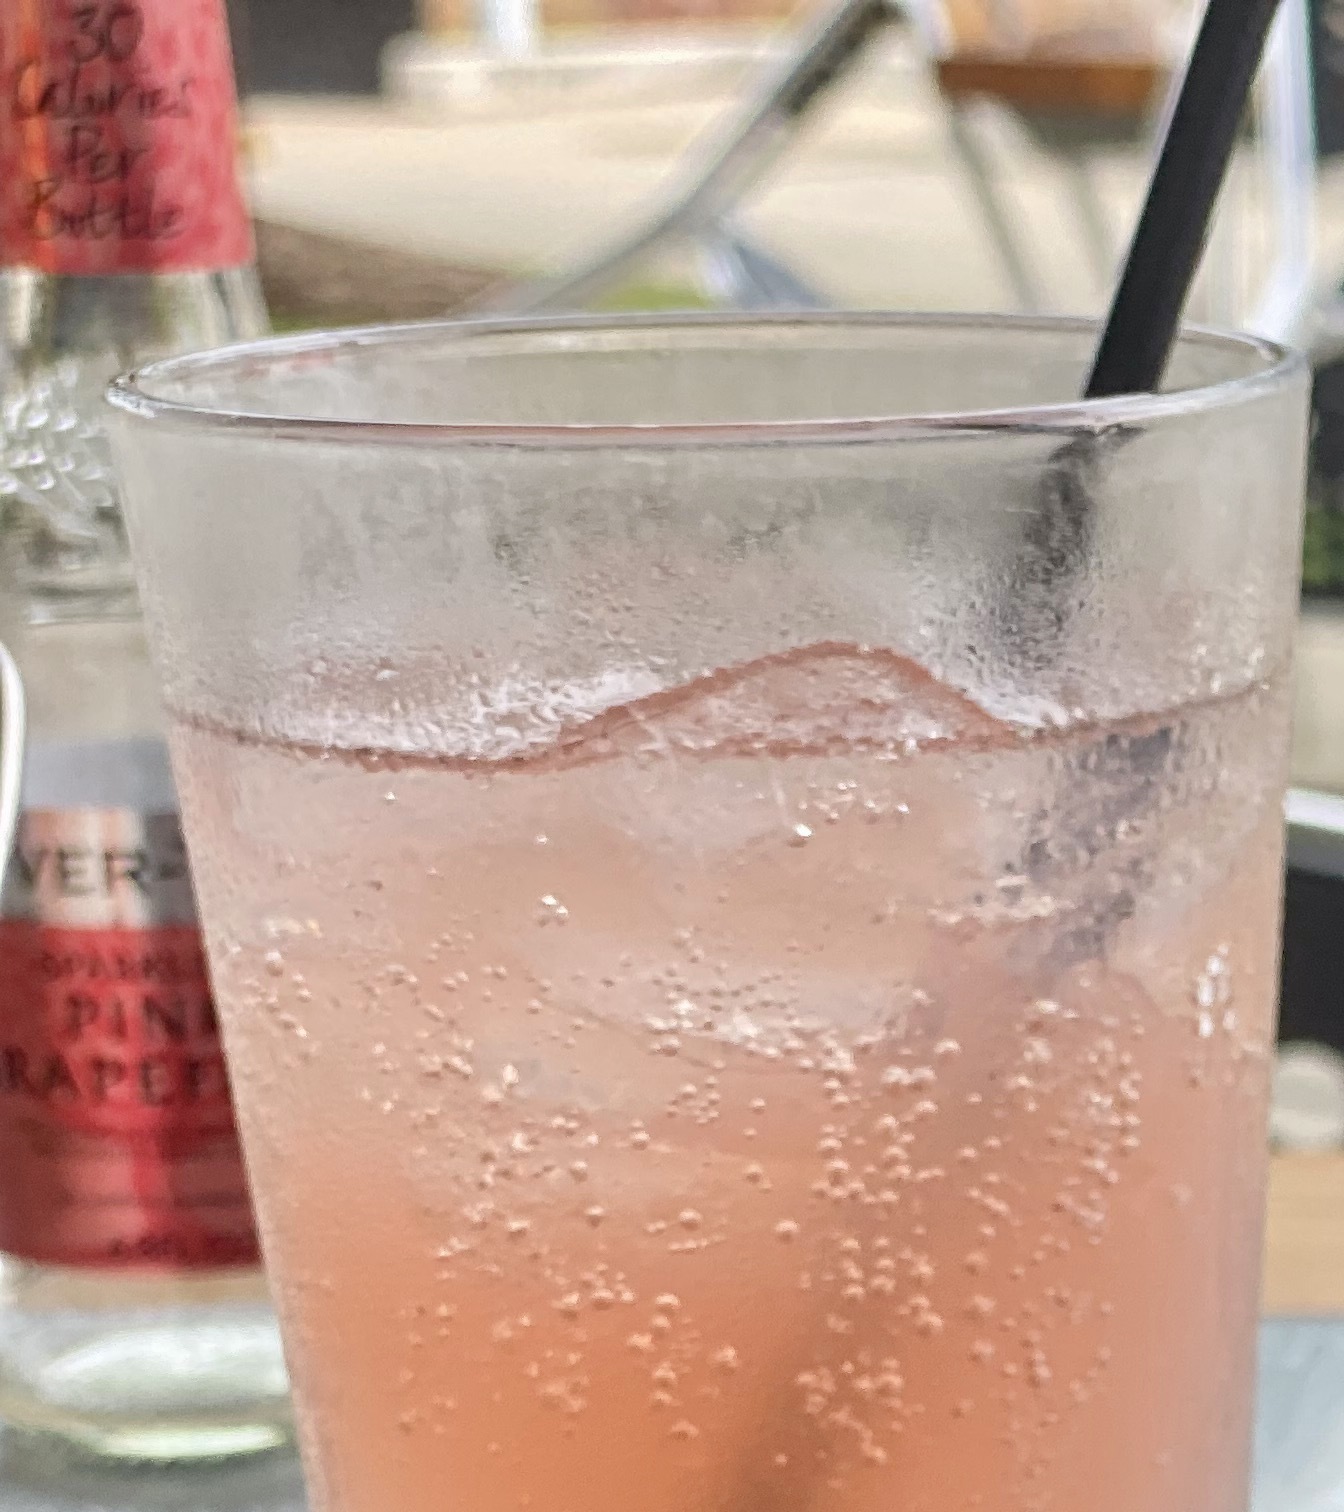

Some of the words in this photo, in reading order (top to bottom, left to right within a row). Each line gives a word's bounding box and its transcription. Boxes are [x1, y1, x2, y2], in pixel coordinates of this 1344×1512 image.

[69, 0, 144, 63] 30
[11, 56, 196, 120] Calories
[69, 125, 147, 184] Per
[29, 178, 188, 241] Bottle
